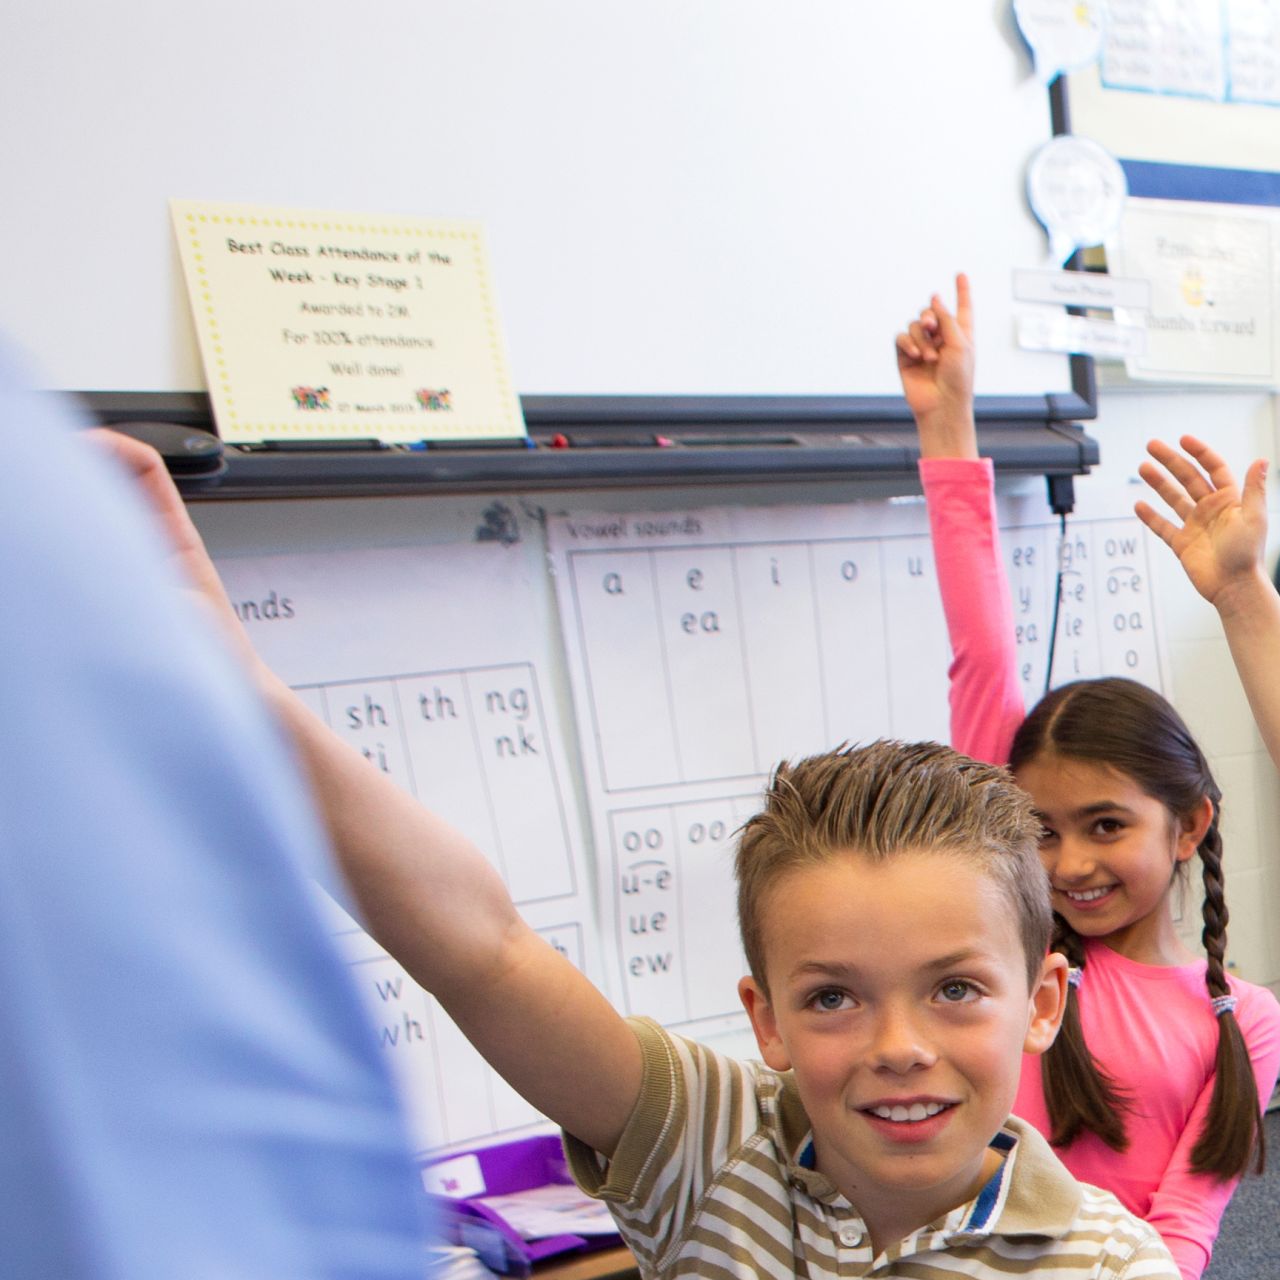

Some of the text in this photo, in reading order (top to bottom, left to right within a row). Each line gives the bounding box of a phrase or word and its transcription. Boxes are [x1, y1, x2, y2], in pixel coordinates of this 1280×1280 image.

[226, 238, 452, 266] Best Class Attendance of the
[268, 268, 314, 284] Week
[333, 272, 359, 289] Key
[368, 274, 408, 291] Stage
[300, 301, 364, 317] Awarded
[368, 303, 382, 317] to
[282, 329, 435, 349] For 100% attendance
[329, 361, 363, 376] Well
[569, 515, 704, 539] Vowel sounds
[604, 571, 623, 595] a
[686, 567, 704, 591] e
[770, 557, 780, 586] i
[841, 560, 858, 582] o
[909, 556, 924, 577] u
[1012, 545, 1036, 568] ee
[1105, 538, 1136, 557] ow
[232, 590, 295, 623] nds
[1019, 587, 1032, 613] y
[1107, 574, 1142, 595] o-e
[681, 610, 1143, 644] ea ea ie oa
[1022, 649, 1139, 682] e i o
[346, 686, 531, 730] sh th ng
[496, 726, 539, 758] nk
[623, 820, 726, 853] oo oo
[621, 870, 672, 895] u-e
[629, 910, 668, 936] ue
[629, 951, 672, 977] ew
[379, 1010, 425, 1050] wh
